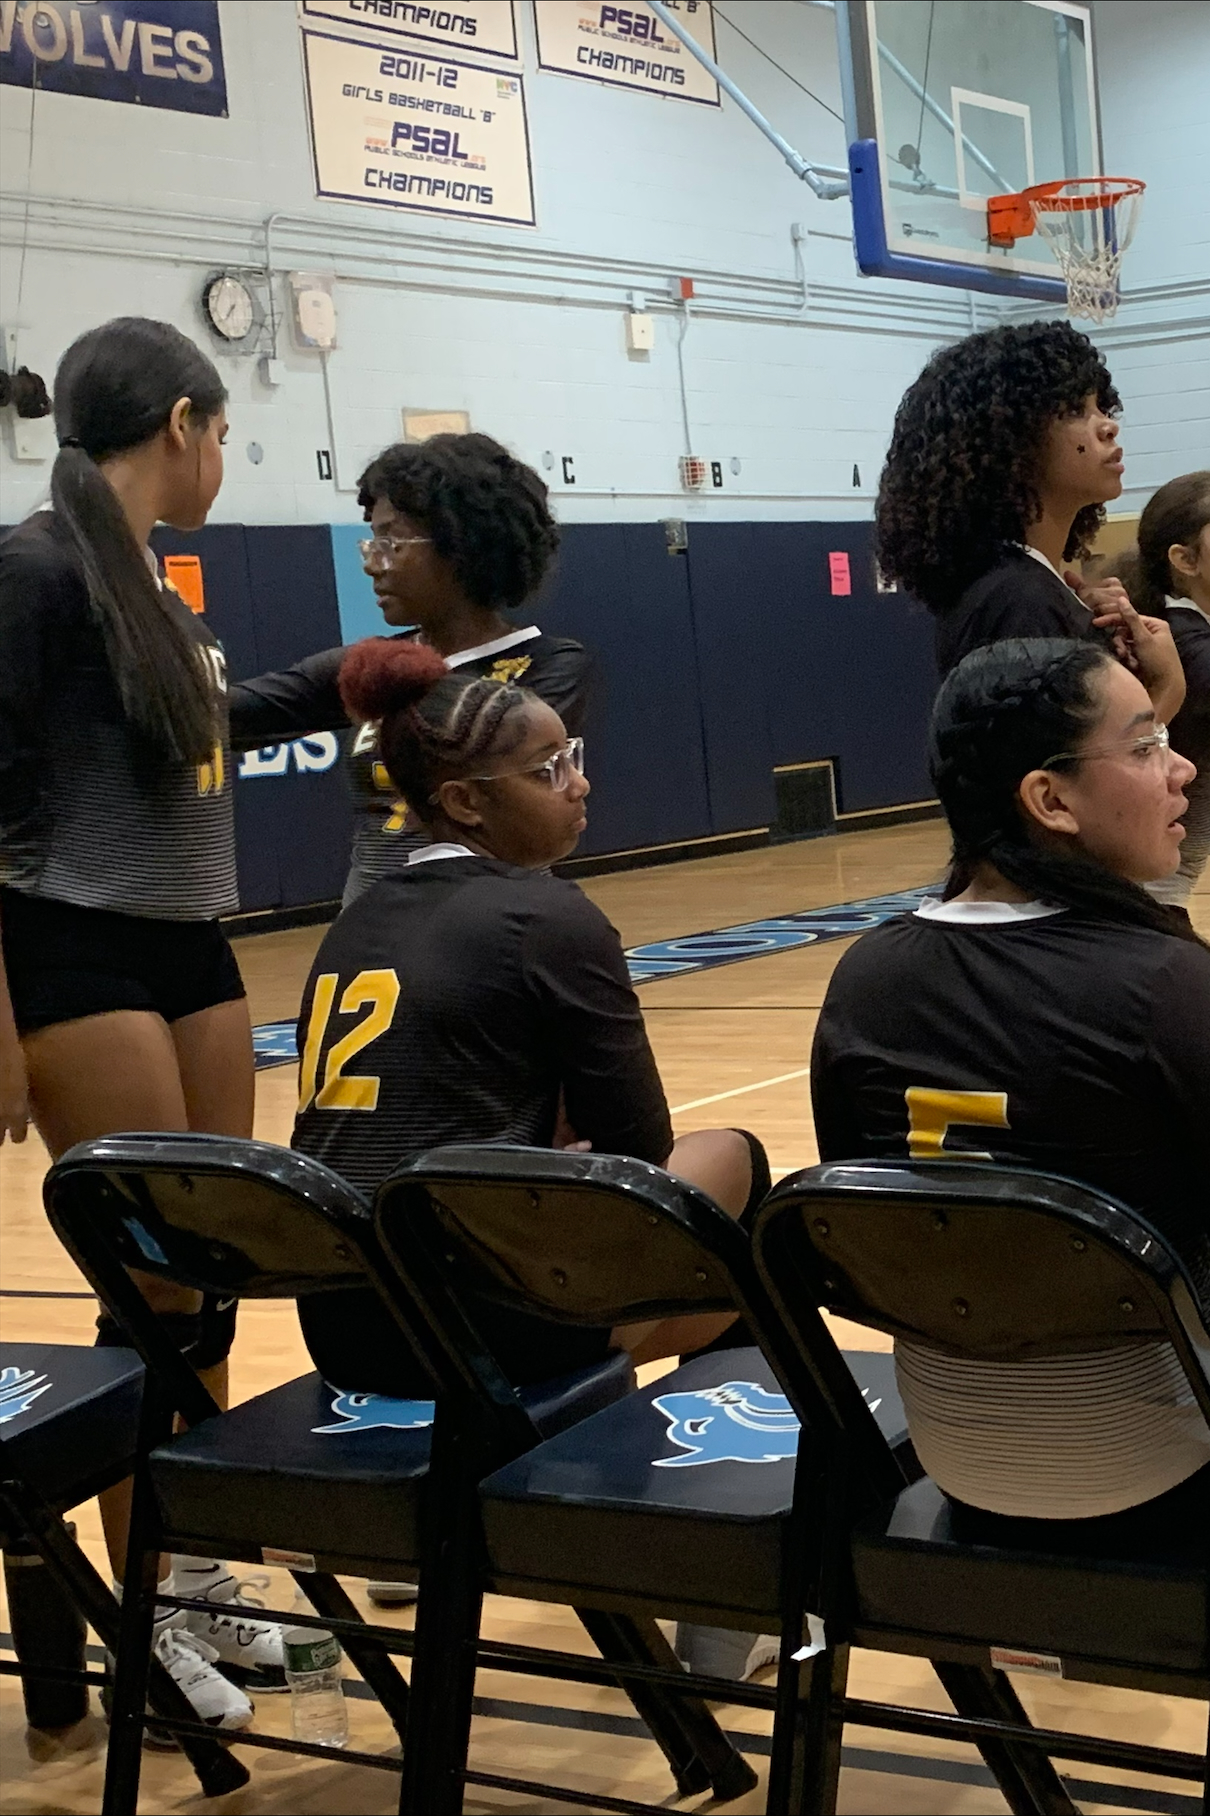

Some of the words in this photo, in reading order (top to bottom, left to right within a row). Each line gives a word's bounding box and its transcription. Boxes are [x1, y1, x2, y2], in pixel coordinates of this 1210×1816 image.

[379, 55, 458, 88] 2011-12
[316, 450, 332, 480] D
[561, 456, 576, 484] C
[711, 461, 722, 487] B
[852, 464, 861, 488] A
[297, 967, 400, 1115] 12
